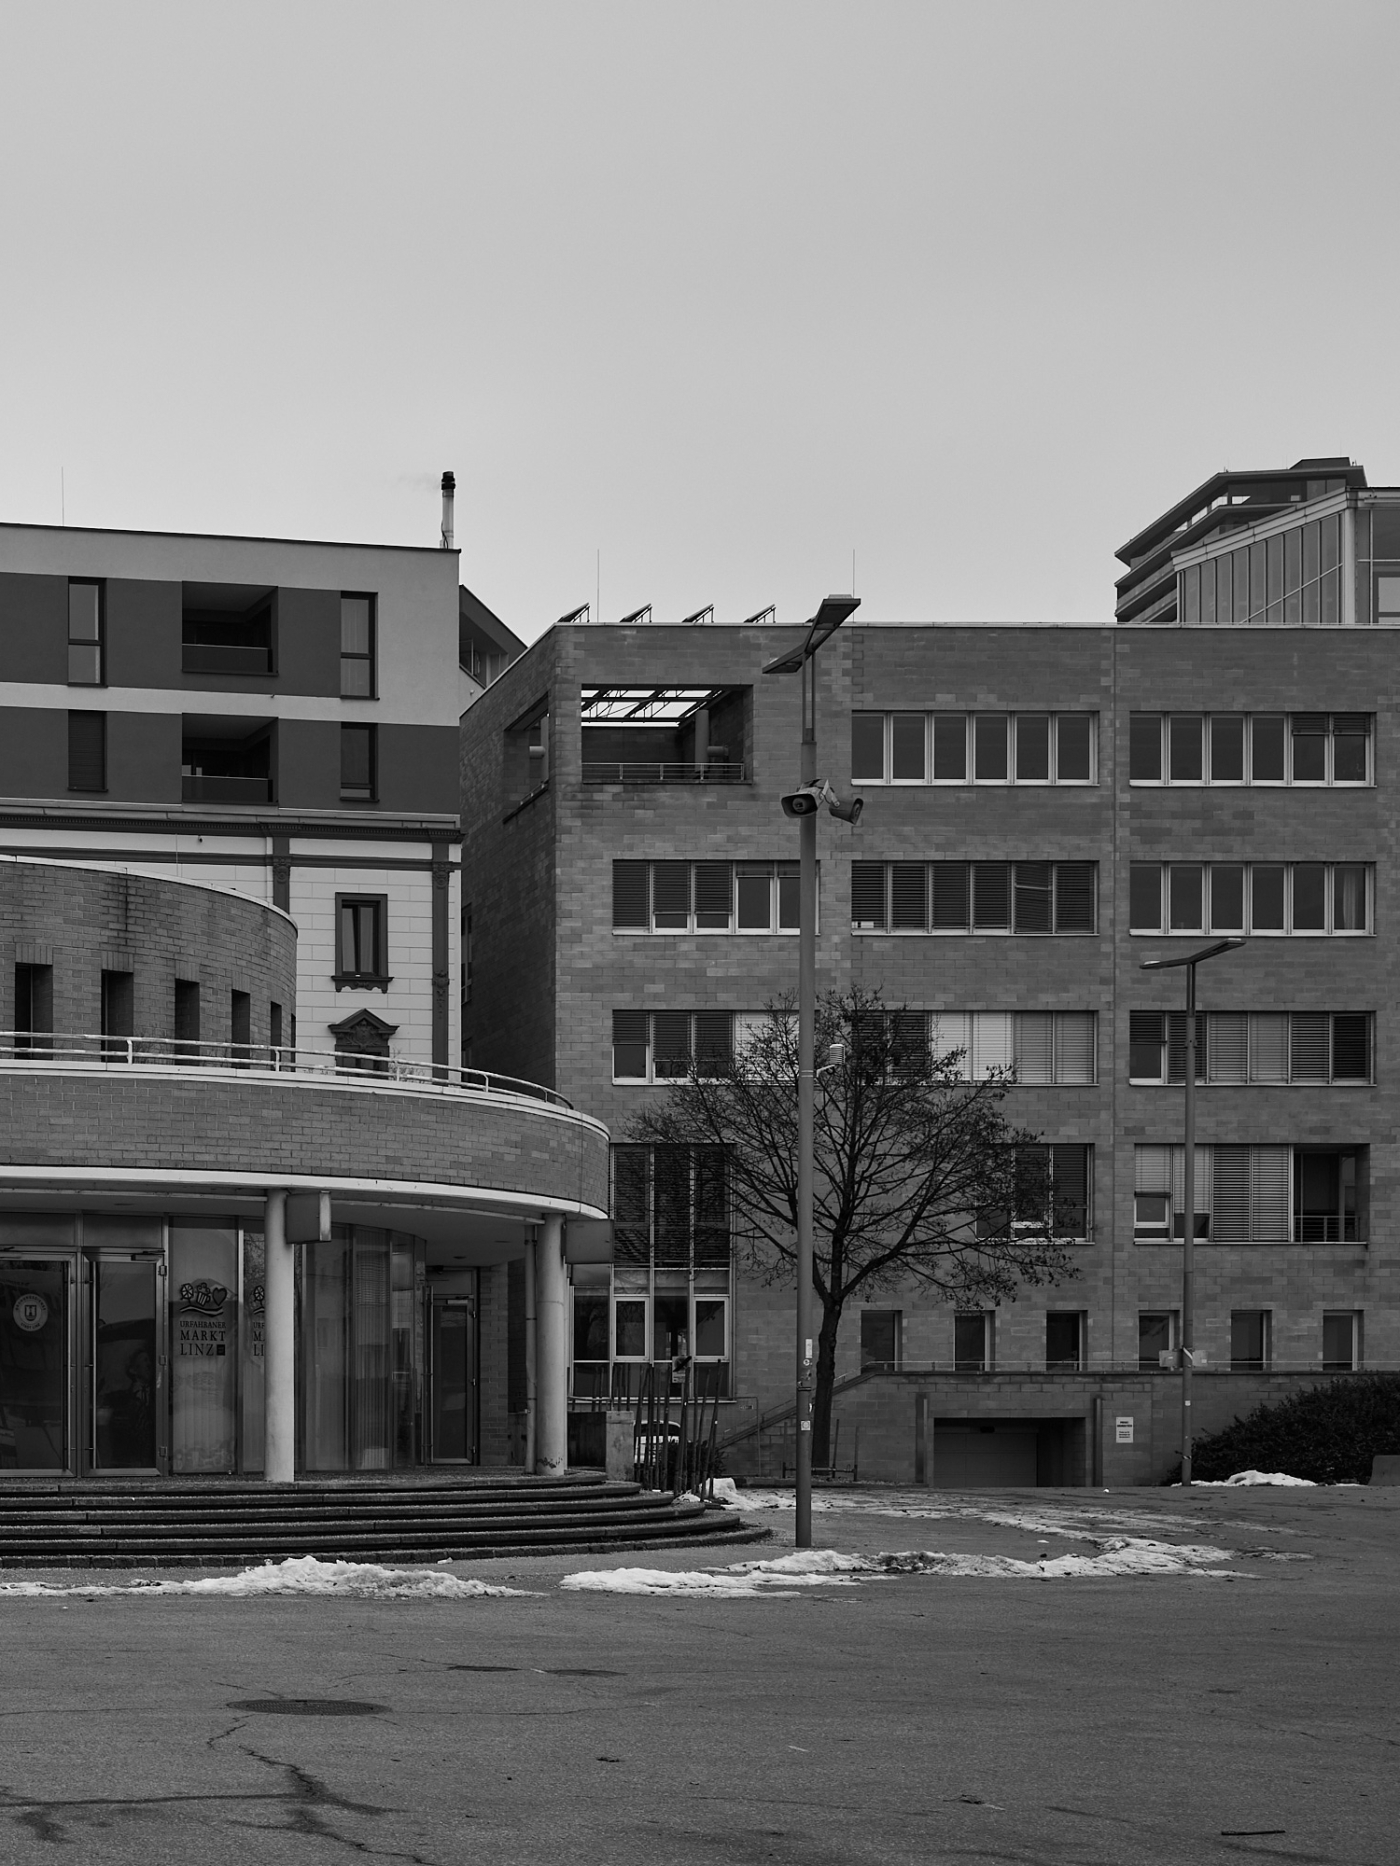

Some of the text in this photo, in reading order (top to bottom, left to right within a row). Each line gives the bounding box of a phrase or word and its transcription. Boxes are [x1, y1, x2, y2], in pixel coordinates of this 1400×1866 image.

[180, 1321, 226, 1329] URFAHRANER
[180, 1330, 226, 1341] MARKT
[180, 1343, 214, 1356] LINZ
